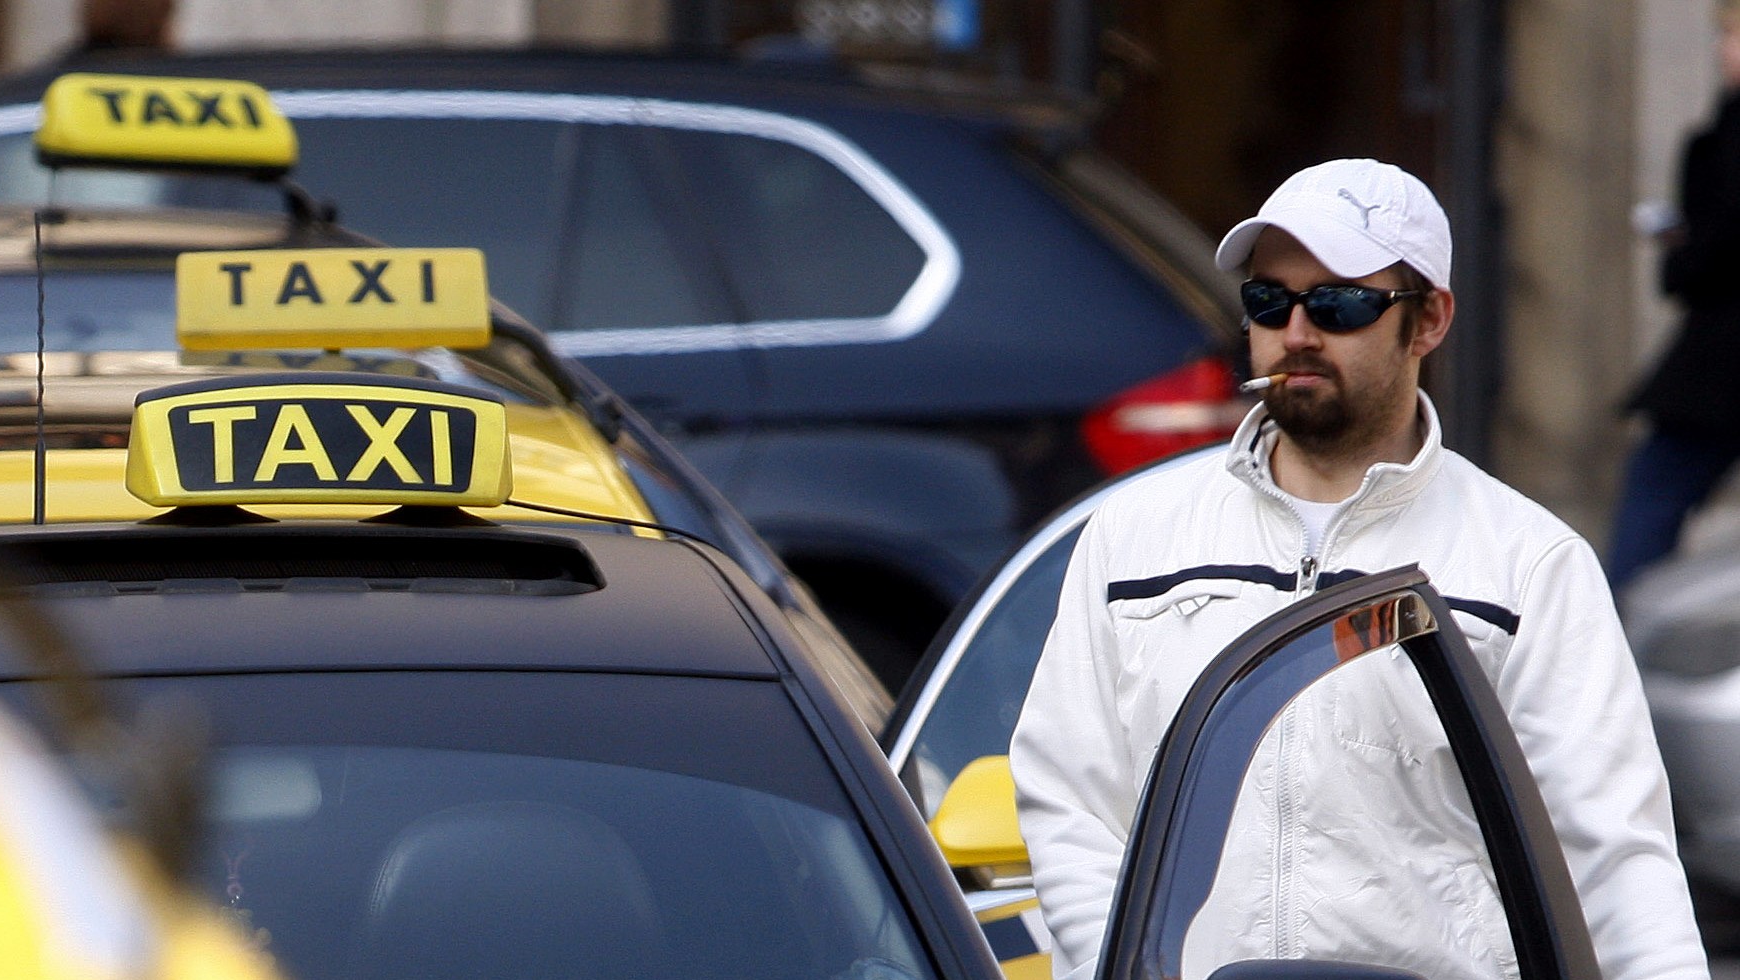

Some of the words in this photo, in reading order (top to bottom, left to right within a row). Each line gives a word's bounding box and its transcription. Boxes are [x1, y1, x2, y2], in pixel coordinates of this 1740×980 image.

[86, 86, 262, 129] TAXI
[219, 259, 435, 306] TAXI
[188, 402, 454, 487] TAXI
